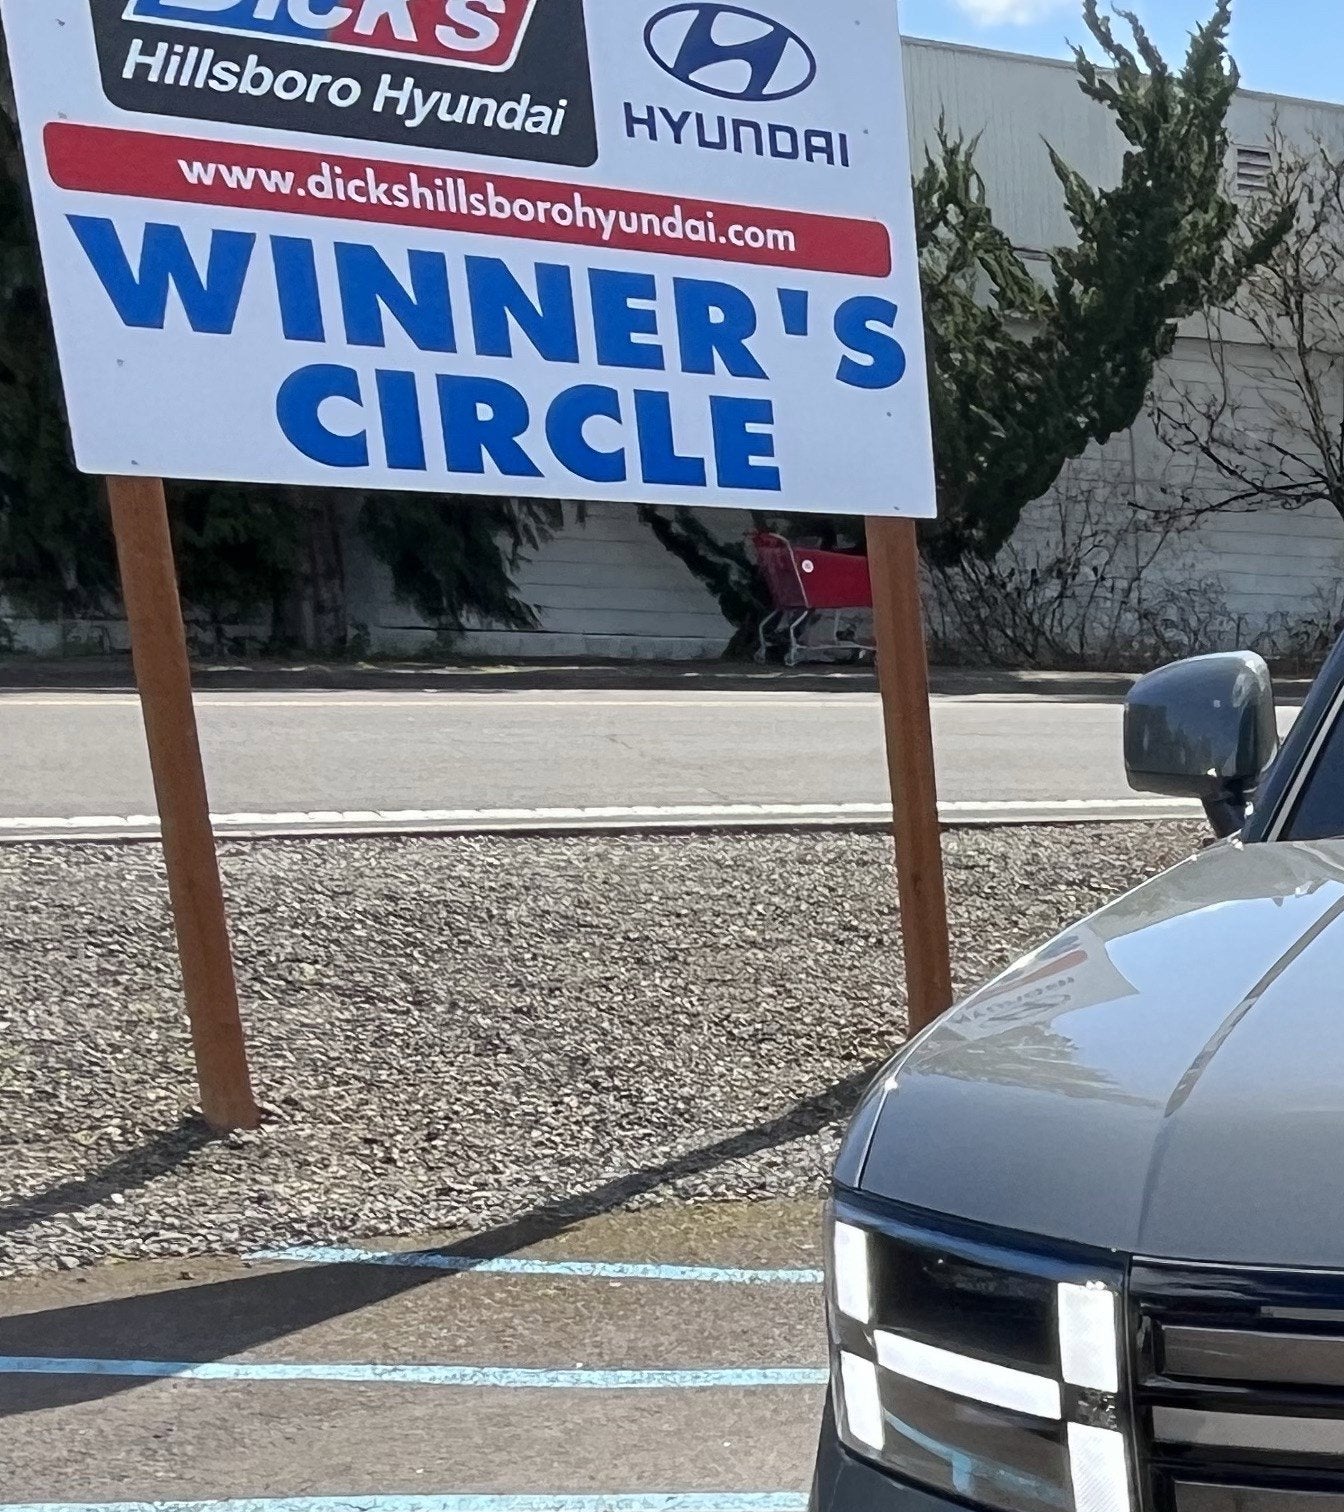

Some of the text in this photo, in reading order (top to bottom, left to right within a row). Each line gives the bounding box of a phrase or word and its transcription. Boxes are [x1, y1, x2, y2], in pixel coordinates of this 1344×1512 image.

[121, 39, 568, 137] Hillsboro Hyundai
[622, 101, 850, 168] HYUNDAI
[178, 157, 797, 252] www.dickshillsborohyundai.com
[65, 213, 907, 390] WINNER'S
[276, 363, 783, 492] CIRCLE
